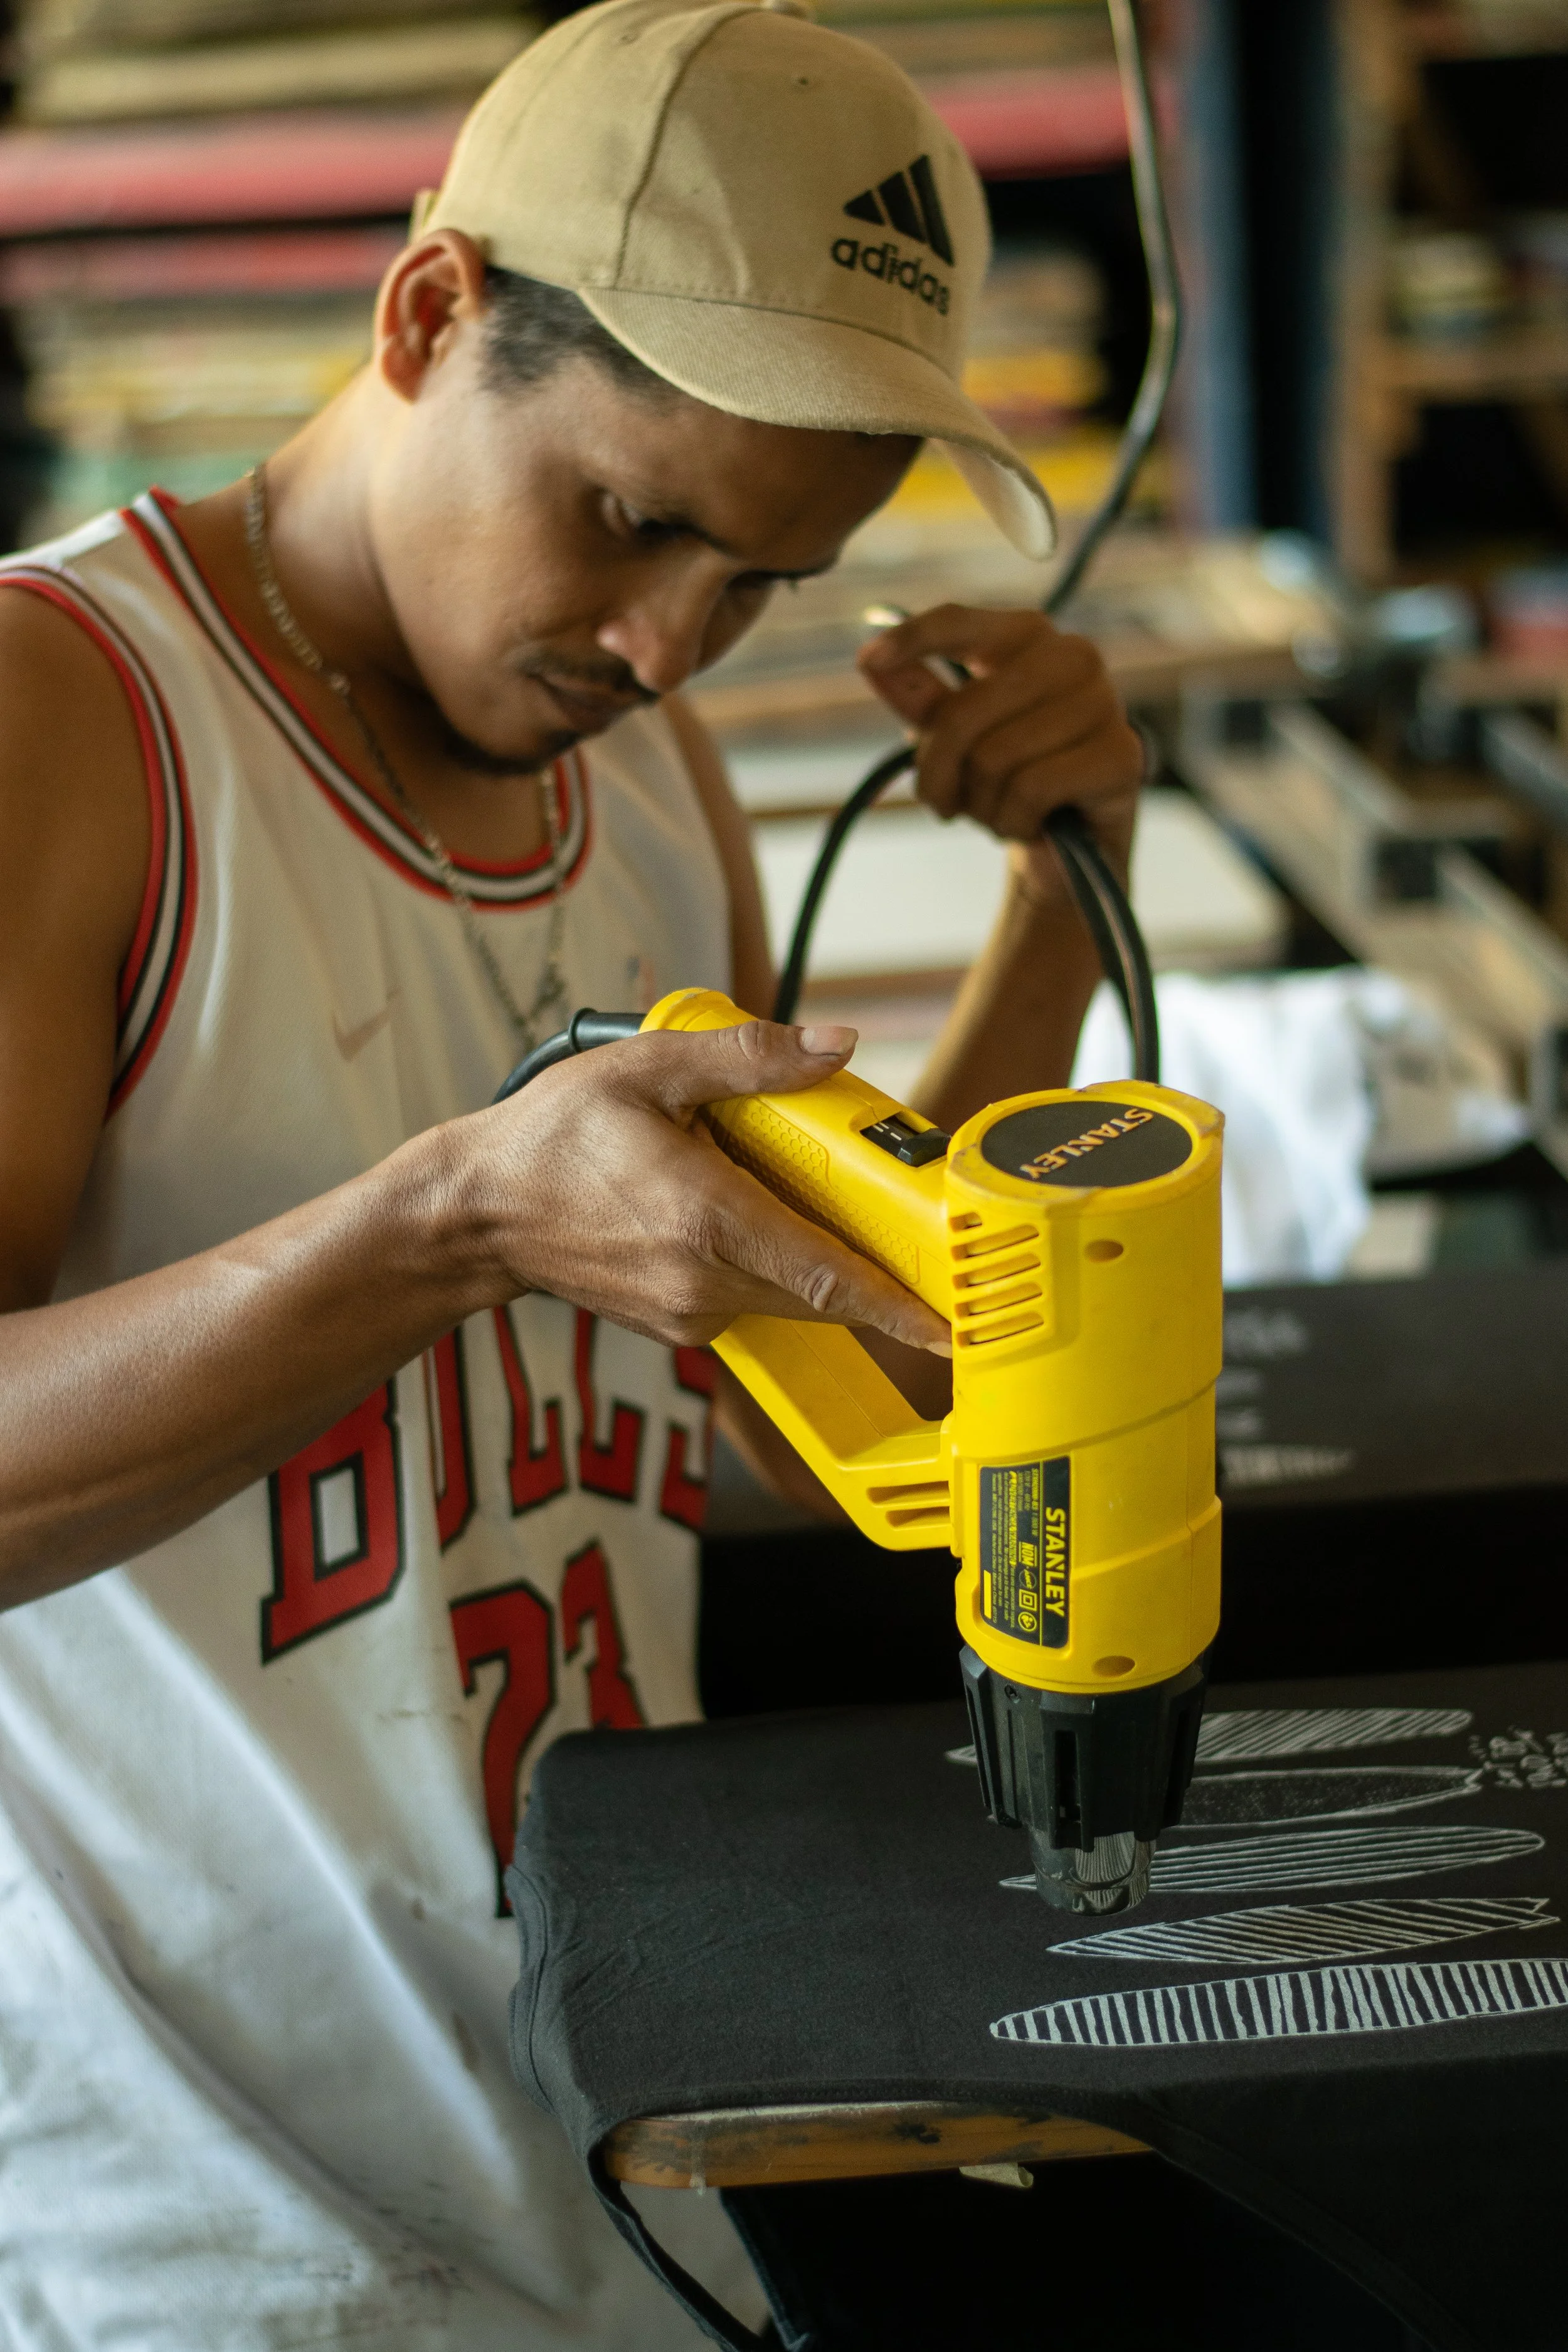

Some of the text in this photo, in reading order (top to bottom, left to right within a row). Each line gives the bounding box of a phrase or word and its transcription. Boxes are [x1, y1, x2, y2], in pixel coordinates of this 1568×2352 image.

[830, 238, 951, 315] adidas
[1019, 1108, 1154, 1179] STANLEY
[1021, 1542, 1035, 1567] NOM
[1045, 1507, 1066, 1617] STANLEY
